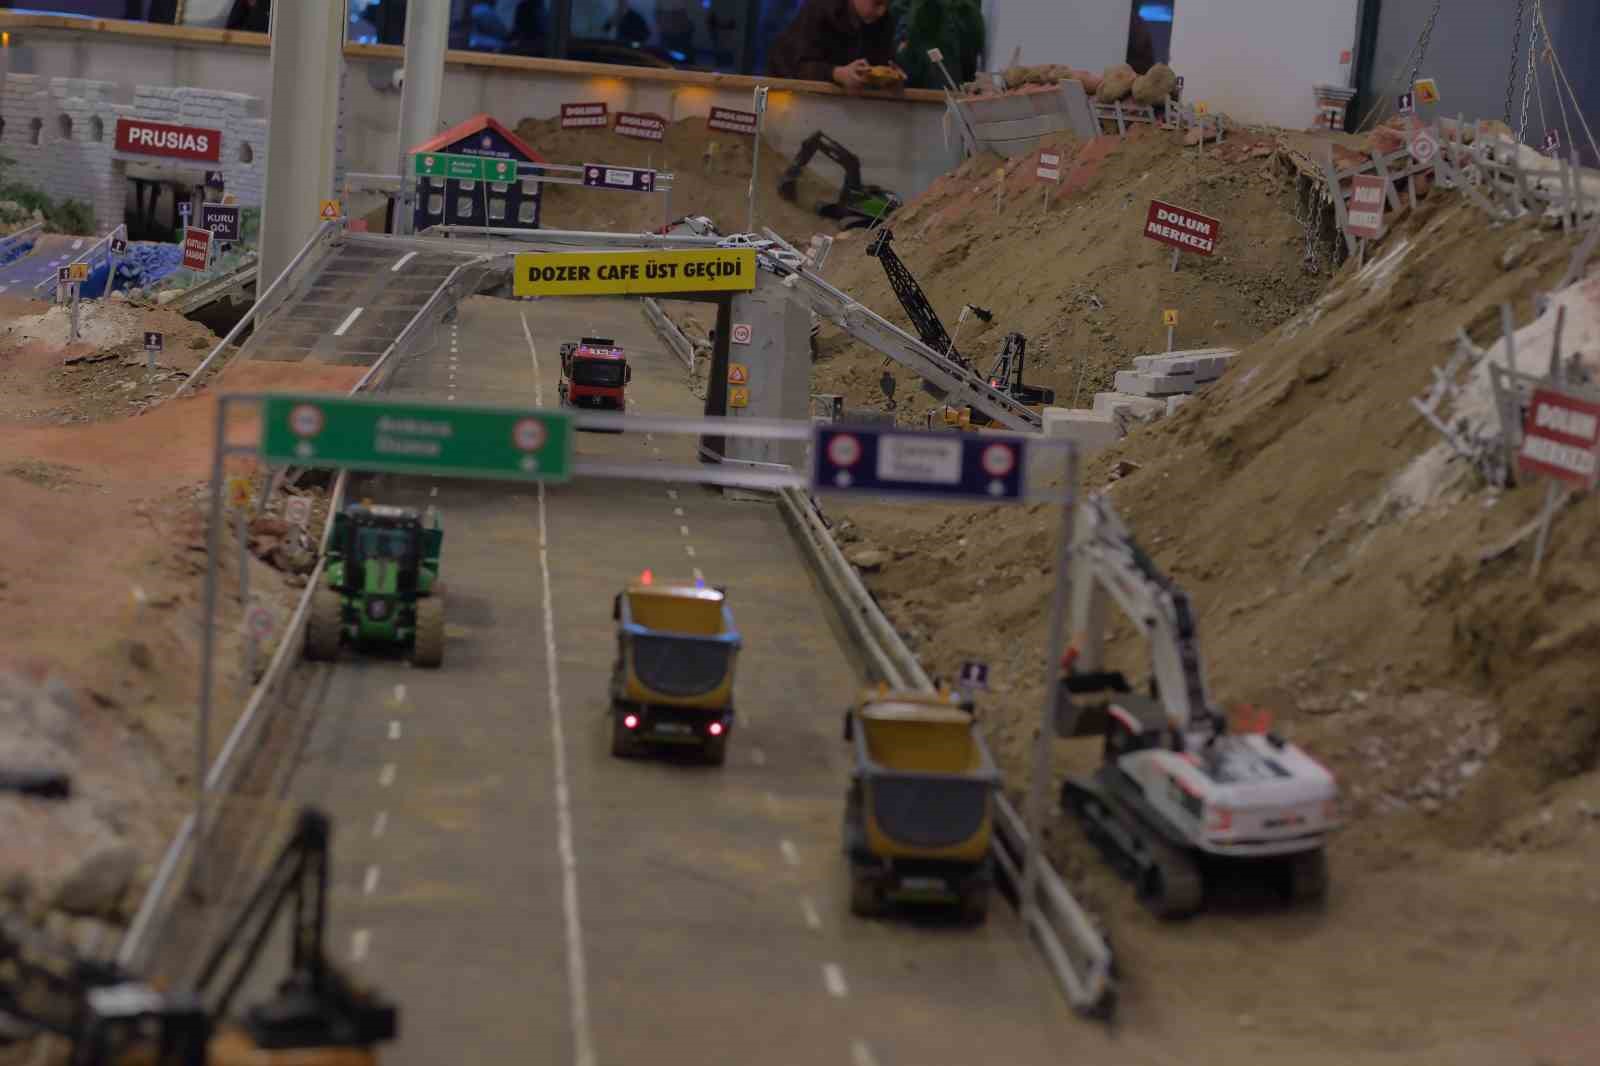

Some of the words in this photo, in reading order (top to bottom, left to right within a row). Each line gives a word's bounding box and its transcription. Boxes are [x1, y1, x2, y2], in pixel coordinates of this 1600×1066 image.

[128, 127, 209, 152] PRUSIAS
[207, 213, 234, 223] KURU
[210, 222, 231, 233] GÖL
[1157, 208, 1211, 236] DOLUM
[1147, 222, 1213, 252] MERKEZİ
[528, 265, 590, 282] DOZER
[597, 264, 639, 281] CAFE
[645, 259, 678, 279] ÜST
[683, 256, 742, 281] GEÇİDİ
